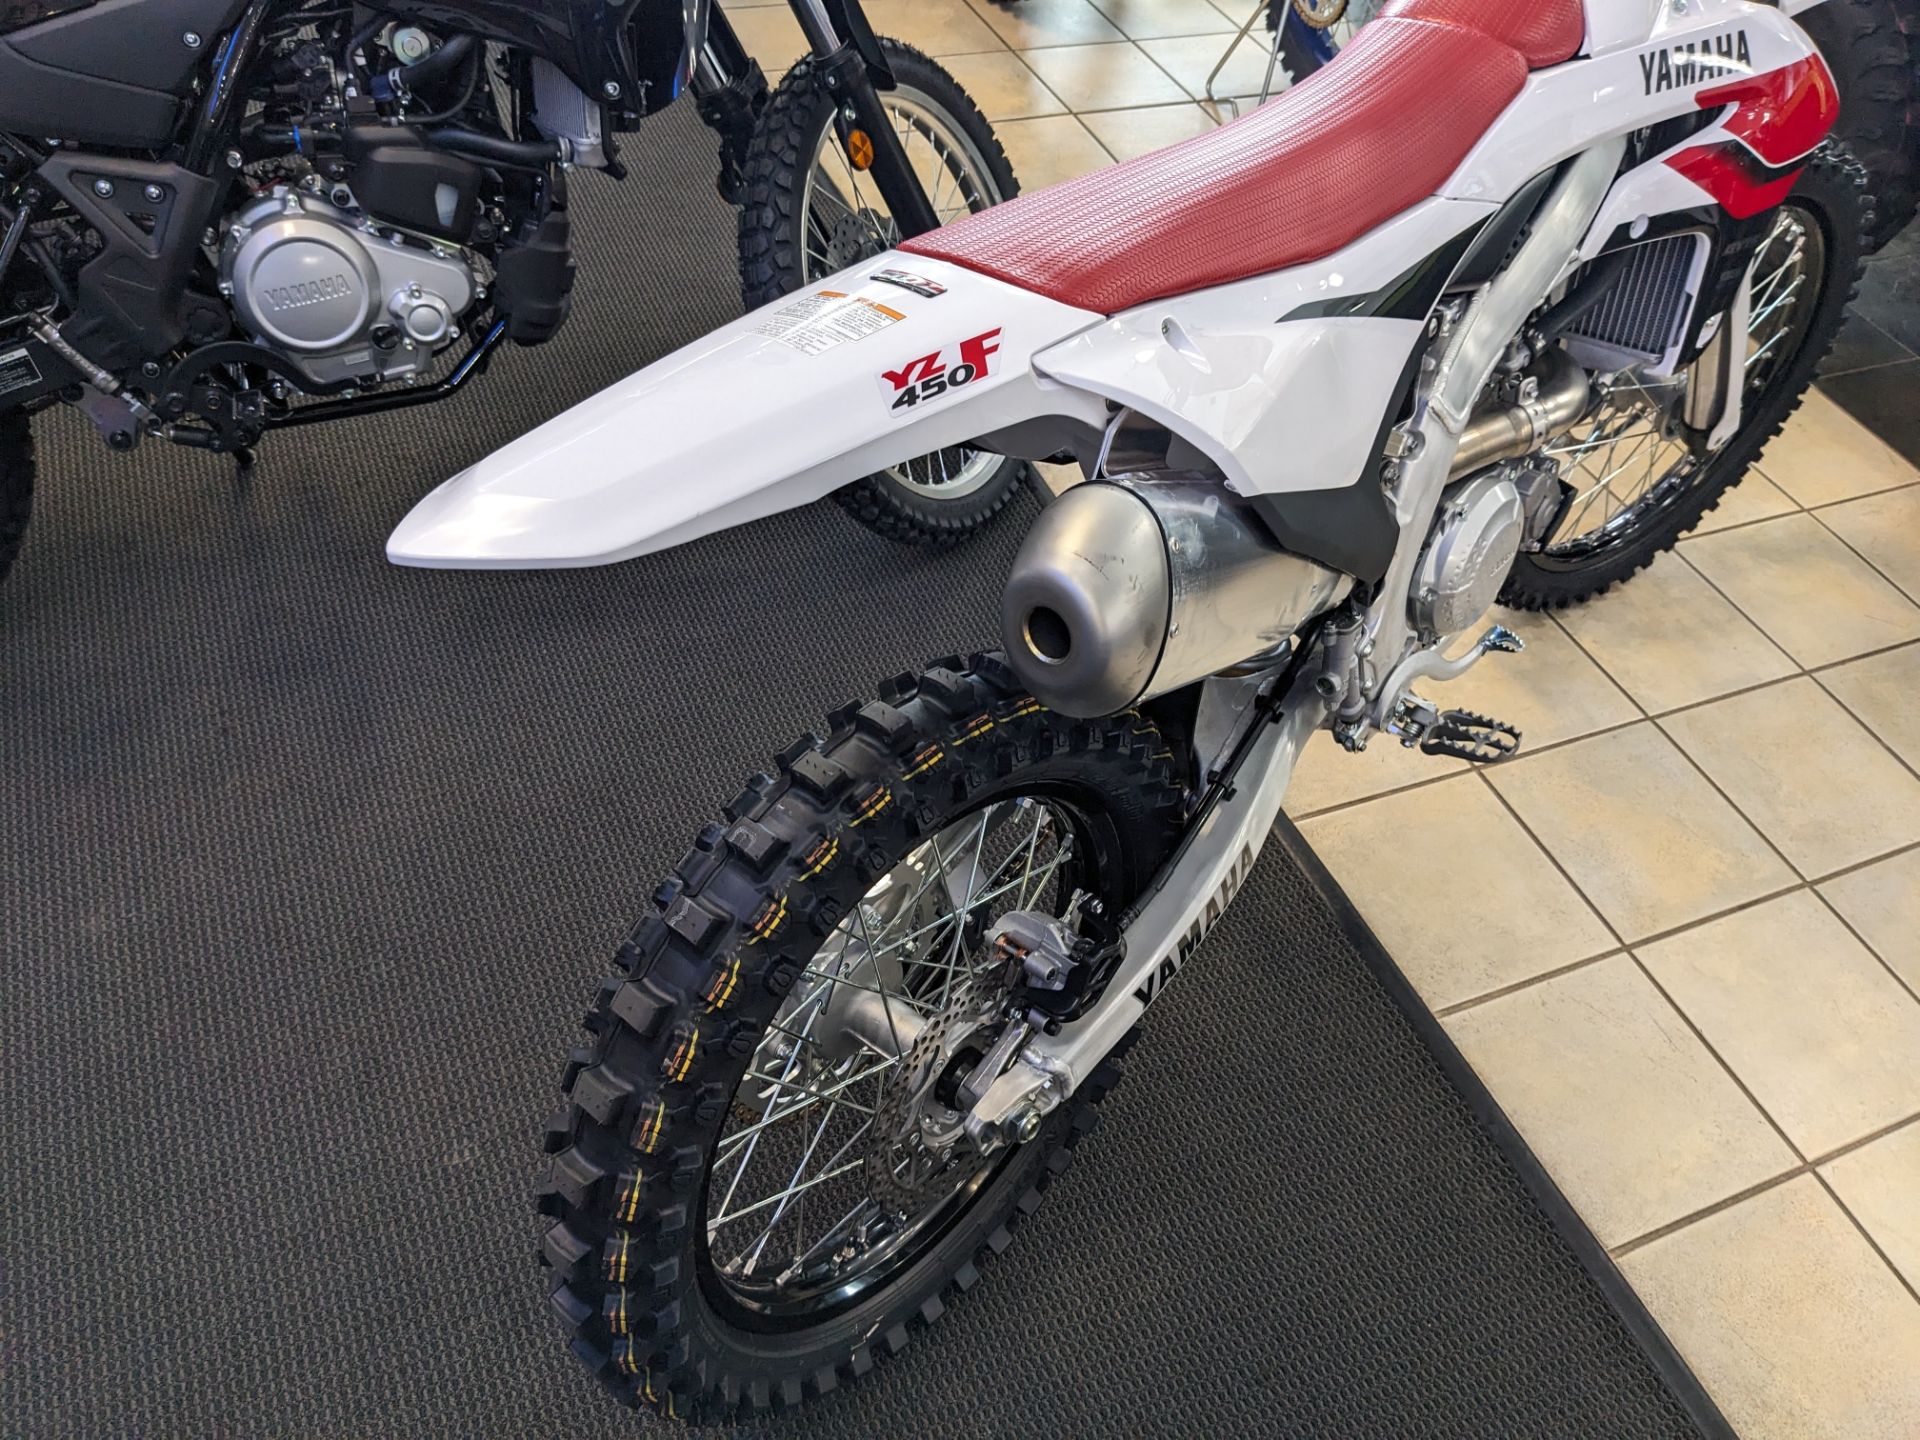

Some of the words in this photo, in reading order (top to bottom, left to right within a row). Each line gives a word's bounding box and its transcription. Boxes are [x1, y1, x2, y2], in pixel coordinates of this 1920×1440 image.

[1638, 29, 1752, 96] YAMAHA
[264, 274, 352, 311] YAMAHA
[881, 350, 947, 391] YZ
[1132, 840, 1254, 1011] YAMAHA
